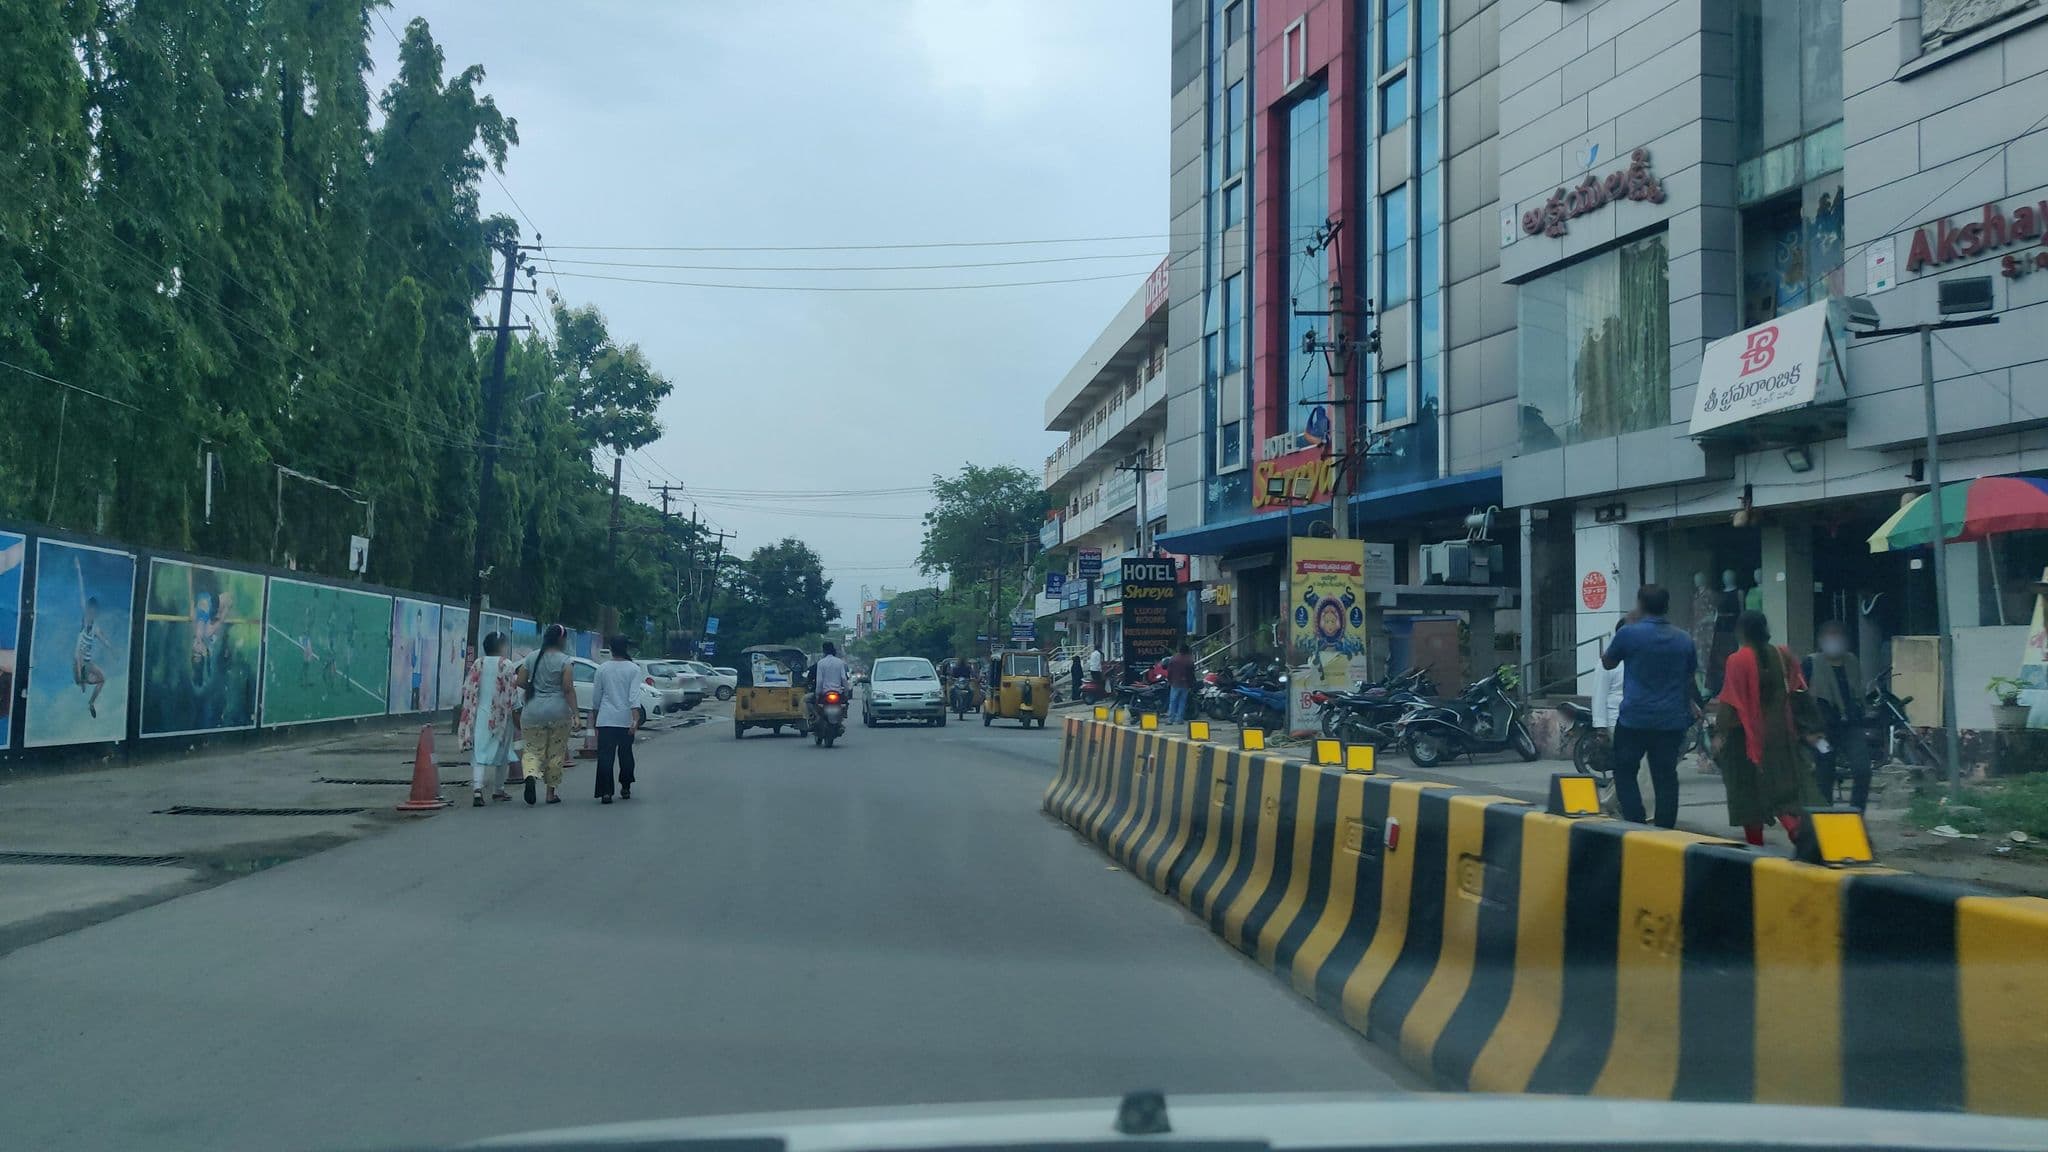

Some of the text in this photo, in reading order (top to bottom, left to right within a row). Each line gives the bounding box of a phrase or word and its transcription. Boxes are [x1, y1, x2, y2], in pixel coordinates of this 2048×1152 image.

[1262, 432, 1297, 461] HOTEL
[1123, 564, 1175, 581] HOTEL
[1124, 584, 1174, 600] Shreya
